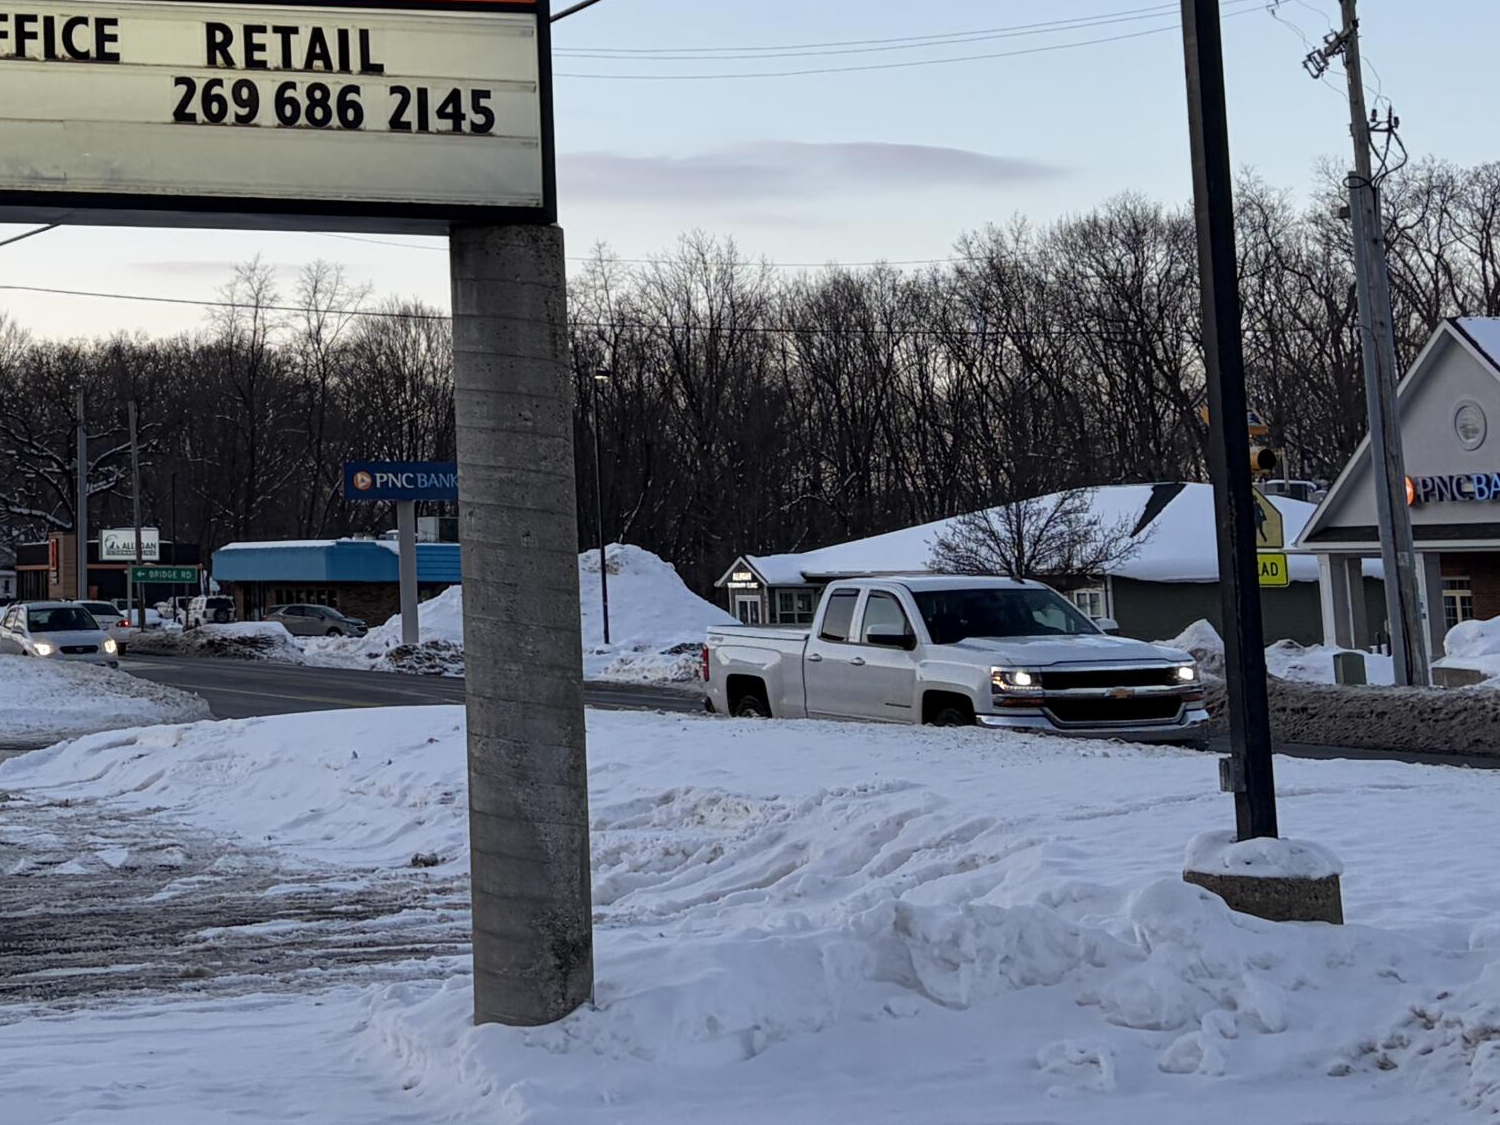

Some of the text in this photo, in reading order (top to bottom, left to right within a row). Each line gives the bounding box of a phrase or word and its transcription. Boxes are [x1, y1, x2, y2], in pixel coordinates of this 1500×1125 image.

[205, 22, 385, 74] RETAIL
[172, 76, 260, 125] 269
[274, 81, 365, 129] 686
[388, 85, 496, 134] 2145
[375, 473, 459, 488] PNC BANK
[1419, 475, 1469, 503] PNC
[122, 541, 157, 550] ALLGAN
[148, 569, 192, 579] BRIDGE RD
